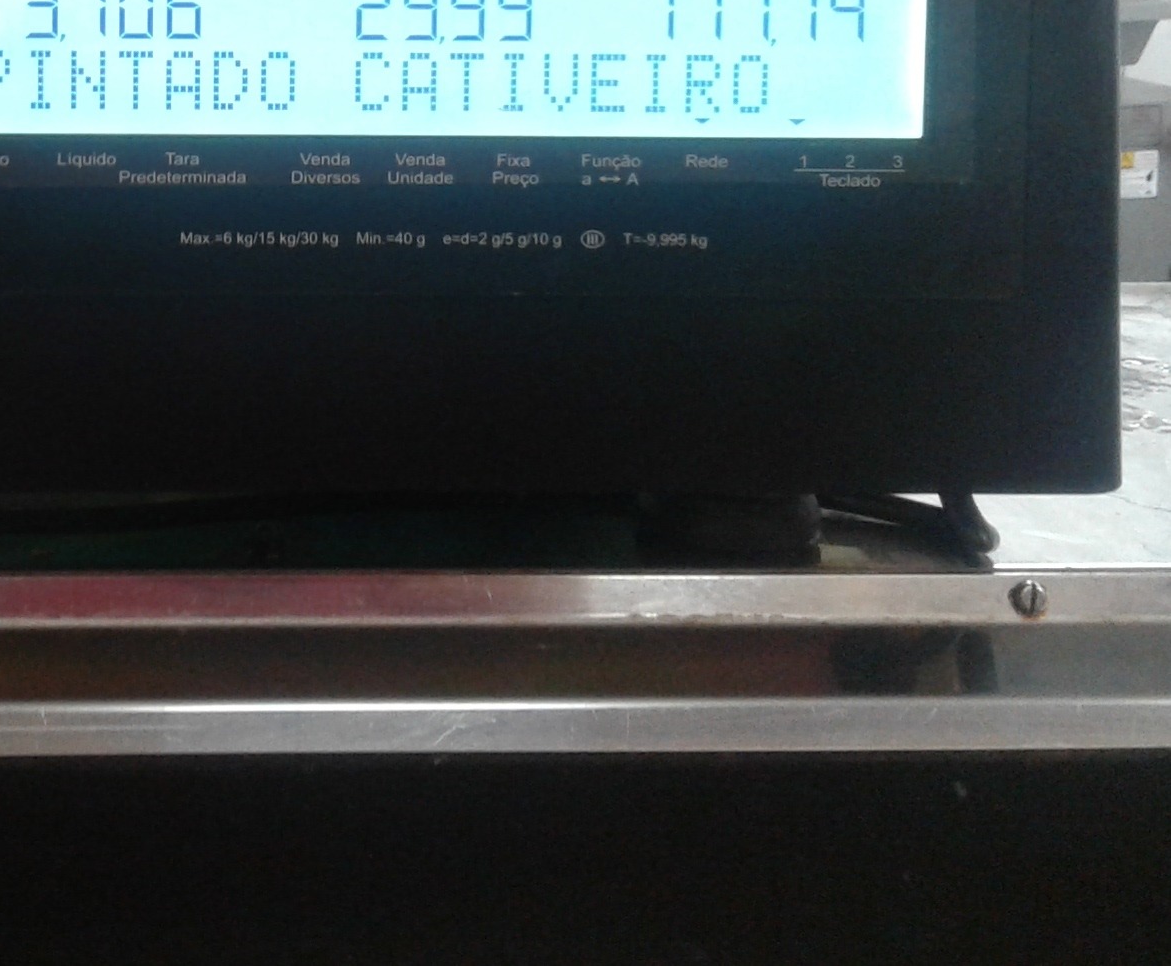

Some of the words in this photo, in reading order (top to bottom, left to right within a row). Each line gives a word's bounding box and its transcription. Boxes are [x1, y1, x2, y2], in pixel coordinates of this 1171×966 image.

[355, 52, 769, 114] CATIVEIRO
[165, 152, 200, 166] Tara
[300, 153, 350, 166] Venda
[395, 153, 446, 167] Venda
[496, 154, 531, 167] Fixa
[582, 154, 642, 171] Função
[686, 155, 728, 168] Rede
[799, 155, 808, 168] 1
[845, 155, 855, 168] 2
[893, 155, 904, 169] 3
[119, 171, 246, 184] Predeterminada
[291, 171, 361, 184] Diversos
[388, 171, 454, 184] Unidade
[492, 171, 539, 188] Preço
[820, 173, 881, 187] Teclado
[322, 232, 339, 248] kg
[691, 234, 708, 249] kg
